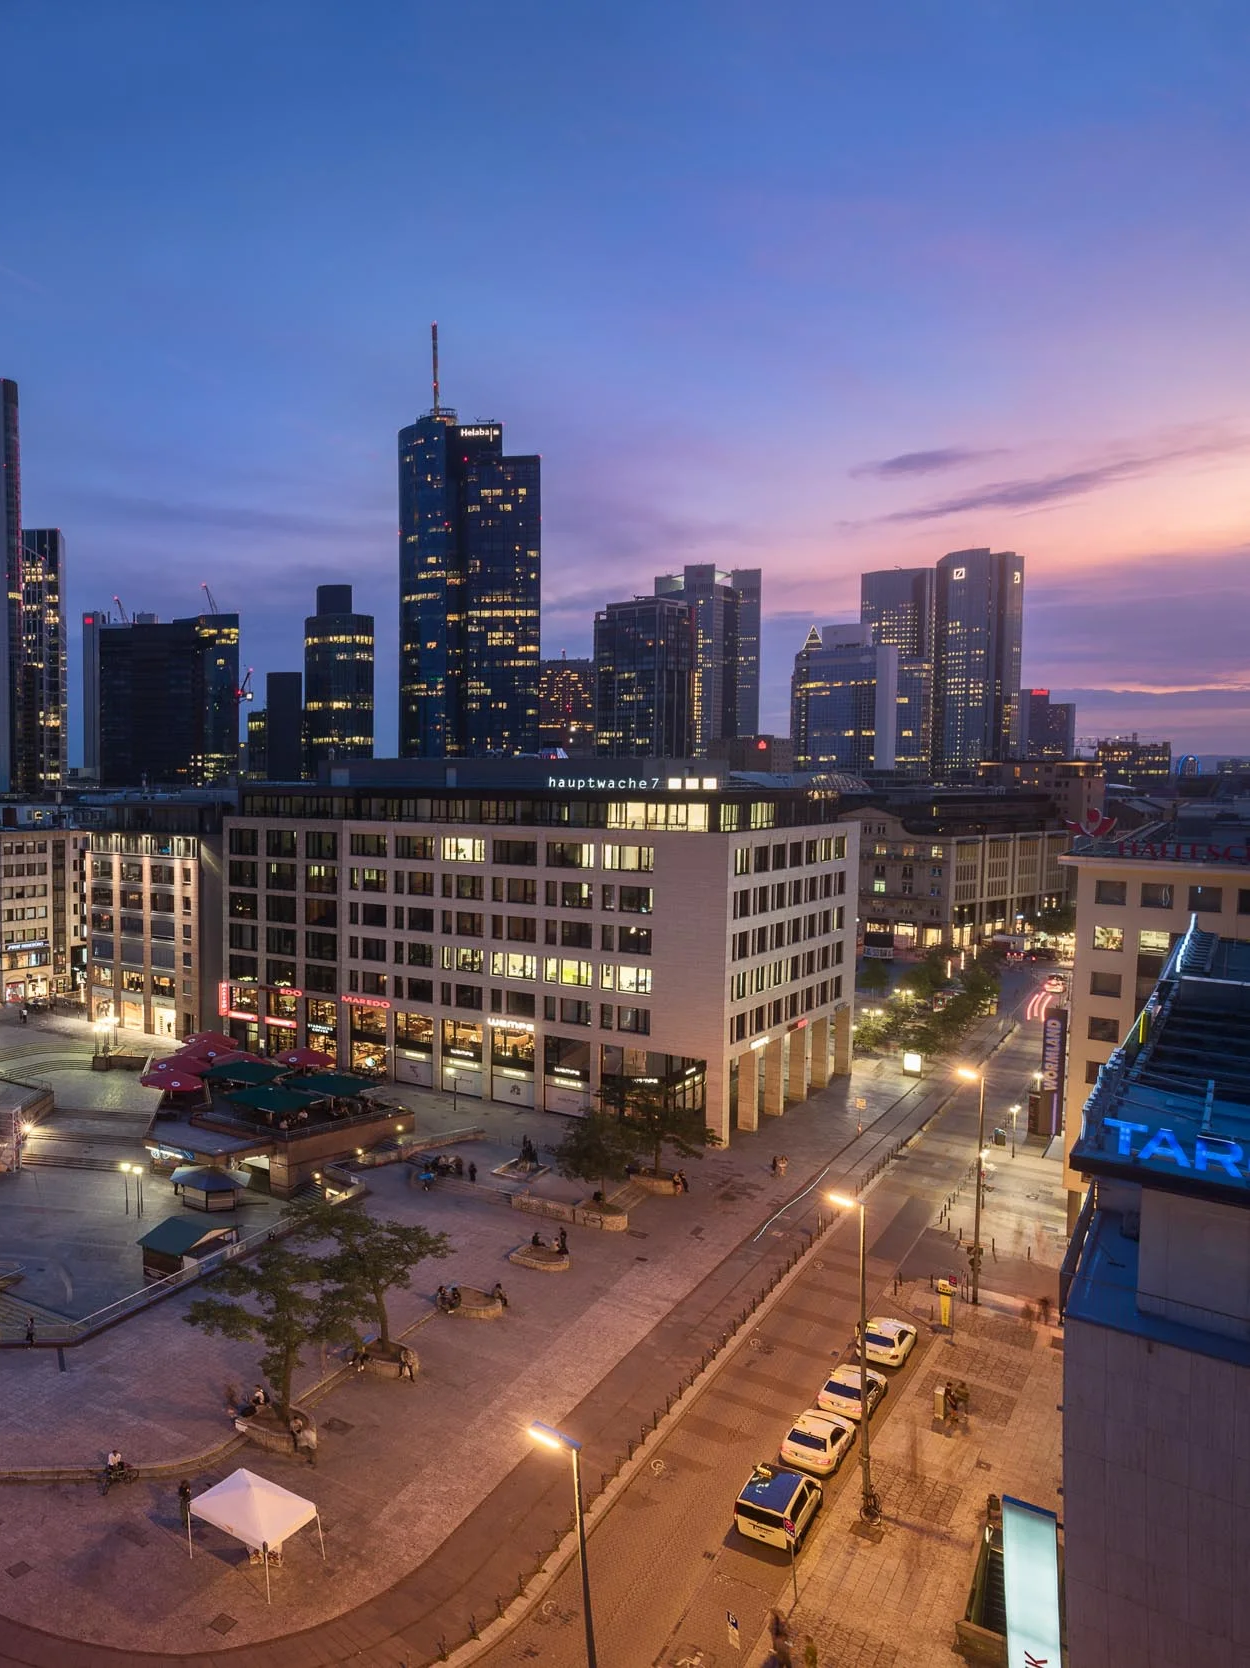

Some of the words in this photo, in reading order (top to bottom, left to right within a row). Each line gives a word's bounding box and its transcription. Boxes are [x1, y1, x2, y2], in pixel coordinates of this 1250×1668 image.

[460, 428, 490, 437] Helaba
[341, 995, 391, 1009] MAREDO
[1043, 1019, 1062, 1091] WORMLAND
[1102, 1117, 1250, 1179] TAR
